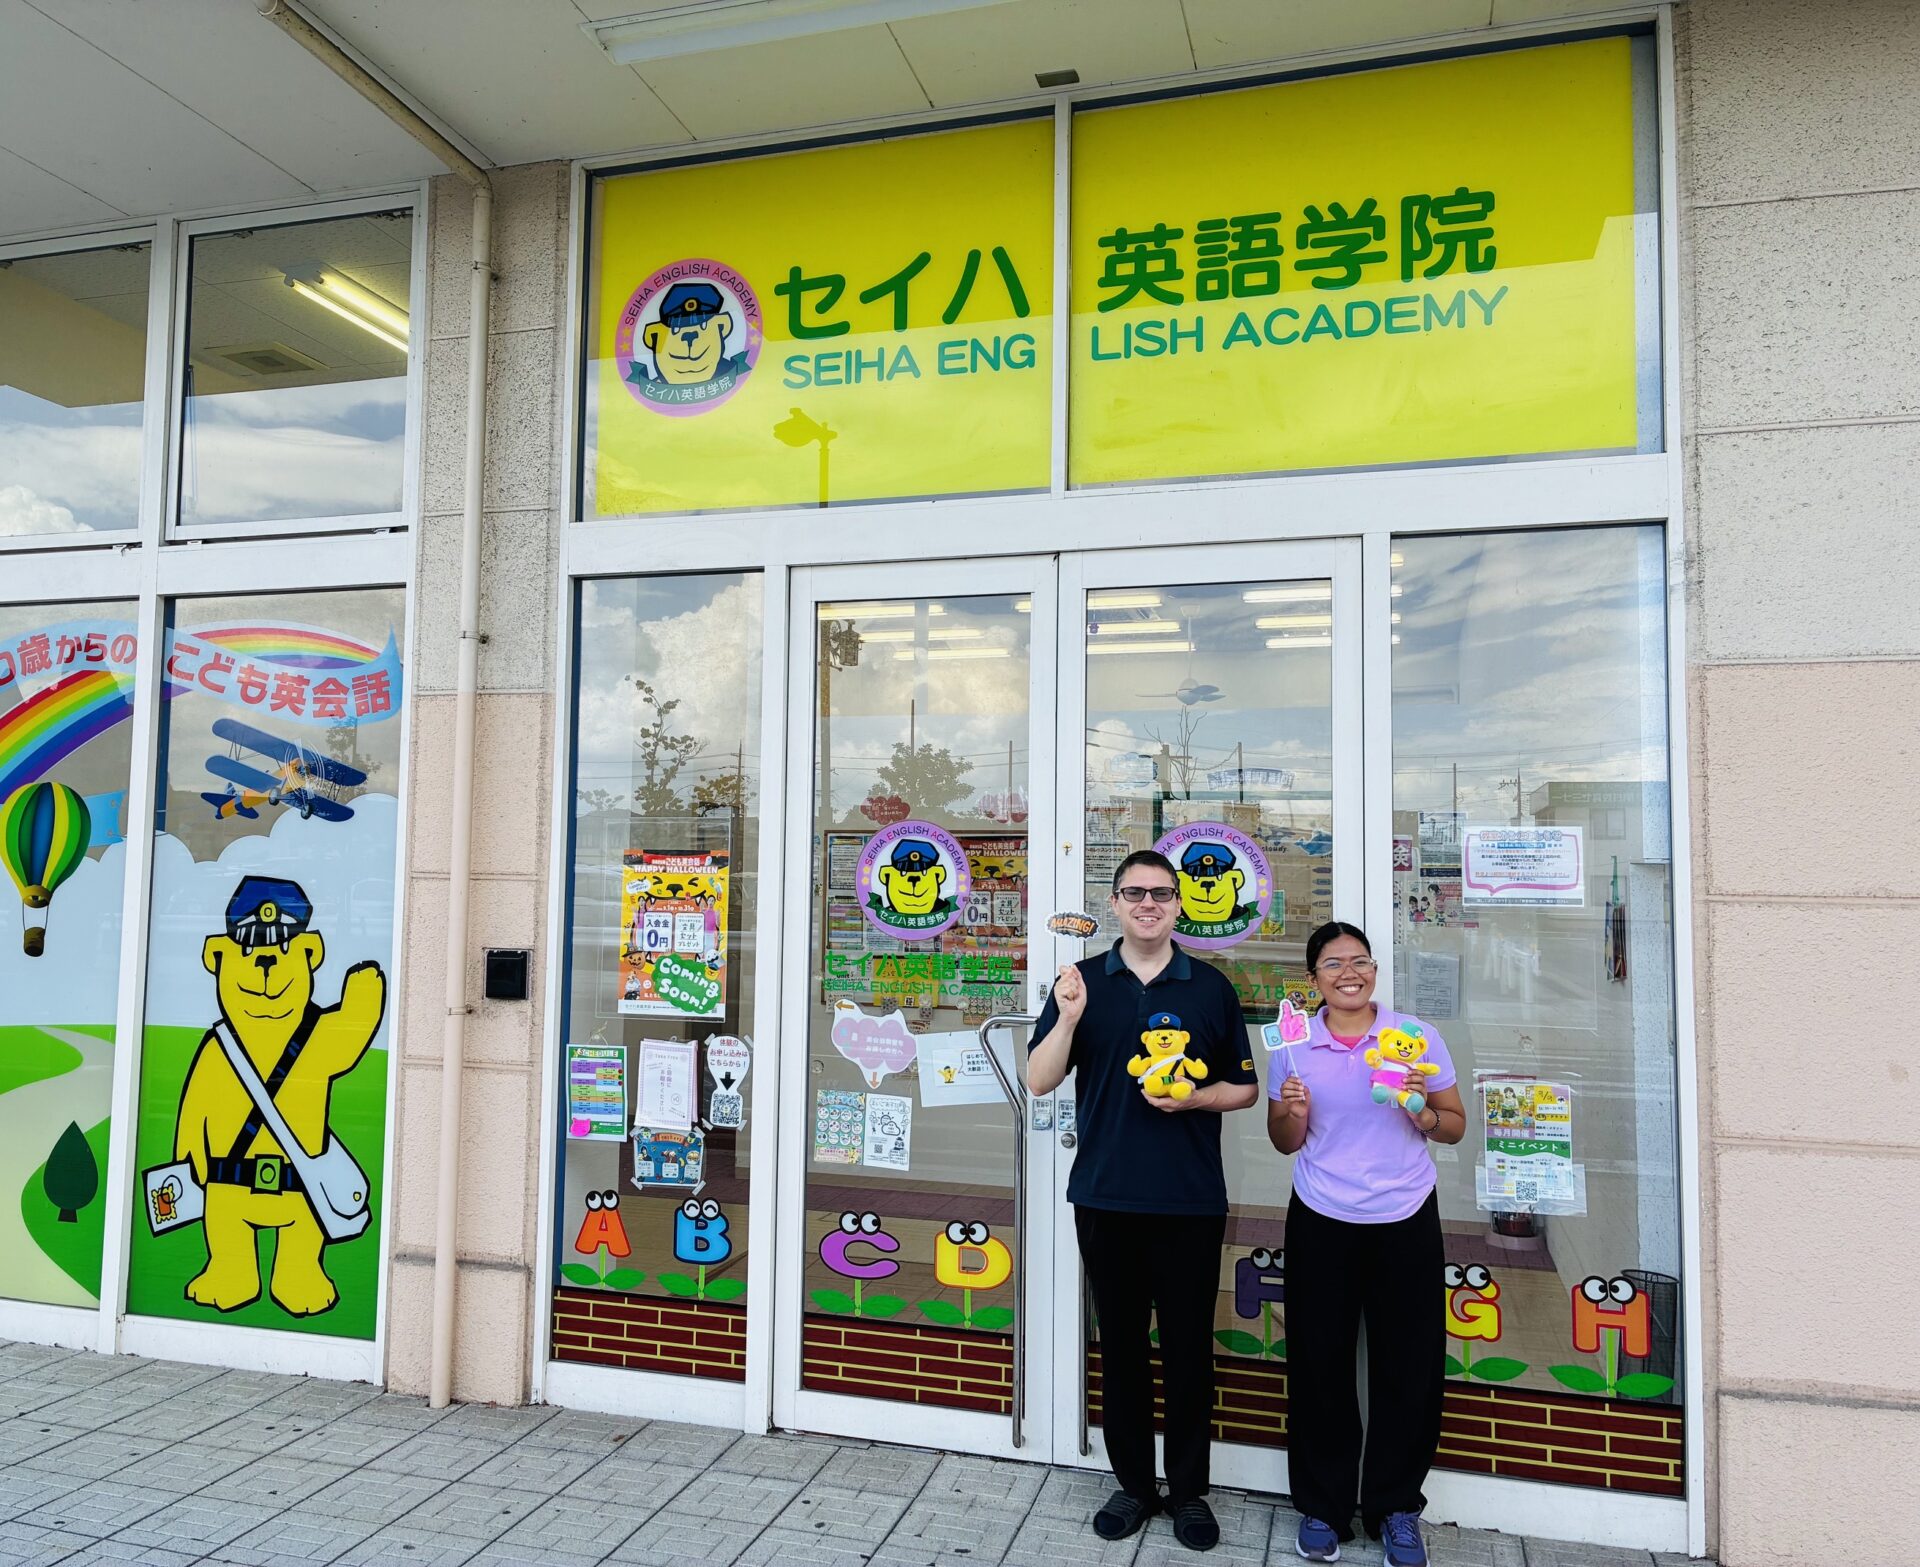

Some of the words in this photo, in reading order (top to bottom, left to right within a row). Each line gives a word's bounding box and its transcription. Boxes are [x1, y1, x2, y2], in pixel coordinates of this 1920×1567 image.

[774, 246, 1031, 339] セイハ
[1097, 187, 1497, 313] 英語学院
[624, 287, 654, 326] SEIHA
[653, 263, 711, 289] ENGLISH
[711, 266, 758, 319] ACADEMY
[782, 345, 921, 389] SEIHA
[938, 333, 1036, 376] ENG
[1092, 316, 1204, 361] LISH
[1222, 286, 1508, 350] ACADEMY
[644, 374, 733, 402] セイハ英語学院
[167, 642, 391, 719] こども英会話
[865, 838, 886, 867] SEIHA
[886, 825, 930, 840] ENGLISH
[930, 831, 965, 872] ACADEMY
[1175, 827, 1223, 844] ENGLISH
[1225, 833, 1266, 876] ACADEMY
[634, 865, 664, 873] HAPPY
[666, 865, 718, 874] HALLOWEEN
[646, 918, 670, 928] 入会金
[878, 910, 946, 927] セイハ英語学院
[968, 906, 988, 922] 0円
[1050, 916, 1095, 935] AMAZING!
[647, 929, 669, 948] 0円
[659, 958, 720, 998] Coming
[824, 951, 1013, 983] セイハ英語学院
[659, 978, 708, 1010] Soon!
[824, 979, 866, 992] SEIHA
[871, 981, 933, 994] ENGLISH
[938, 983, 1014, 997] ACADEMY
[577, 1048, 619, 1058] SCHEDULE
[710, 1048, 748, 1057] お申し込みは
[720, 1038, 739, 1047] 体験の
[1499, 1140, 1559, 1152] ミニイベント
[575, 1207, 632, 1258] A
[673, 1206, 733, 1265] B
[819, 1226, 901, 1280] C
[934, 1231, 1013, 1290] D
[1445, 1277, 1502, 1342] G
[1572, 1284, 1651, 1358] H
